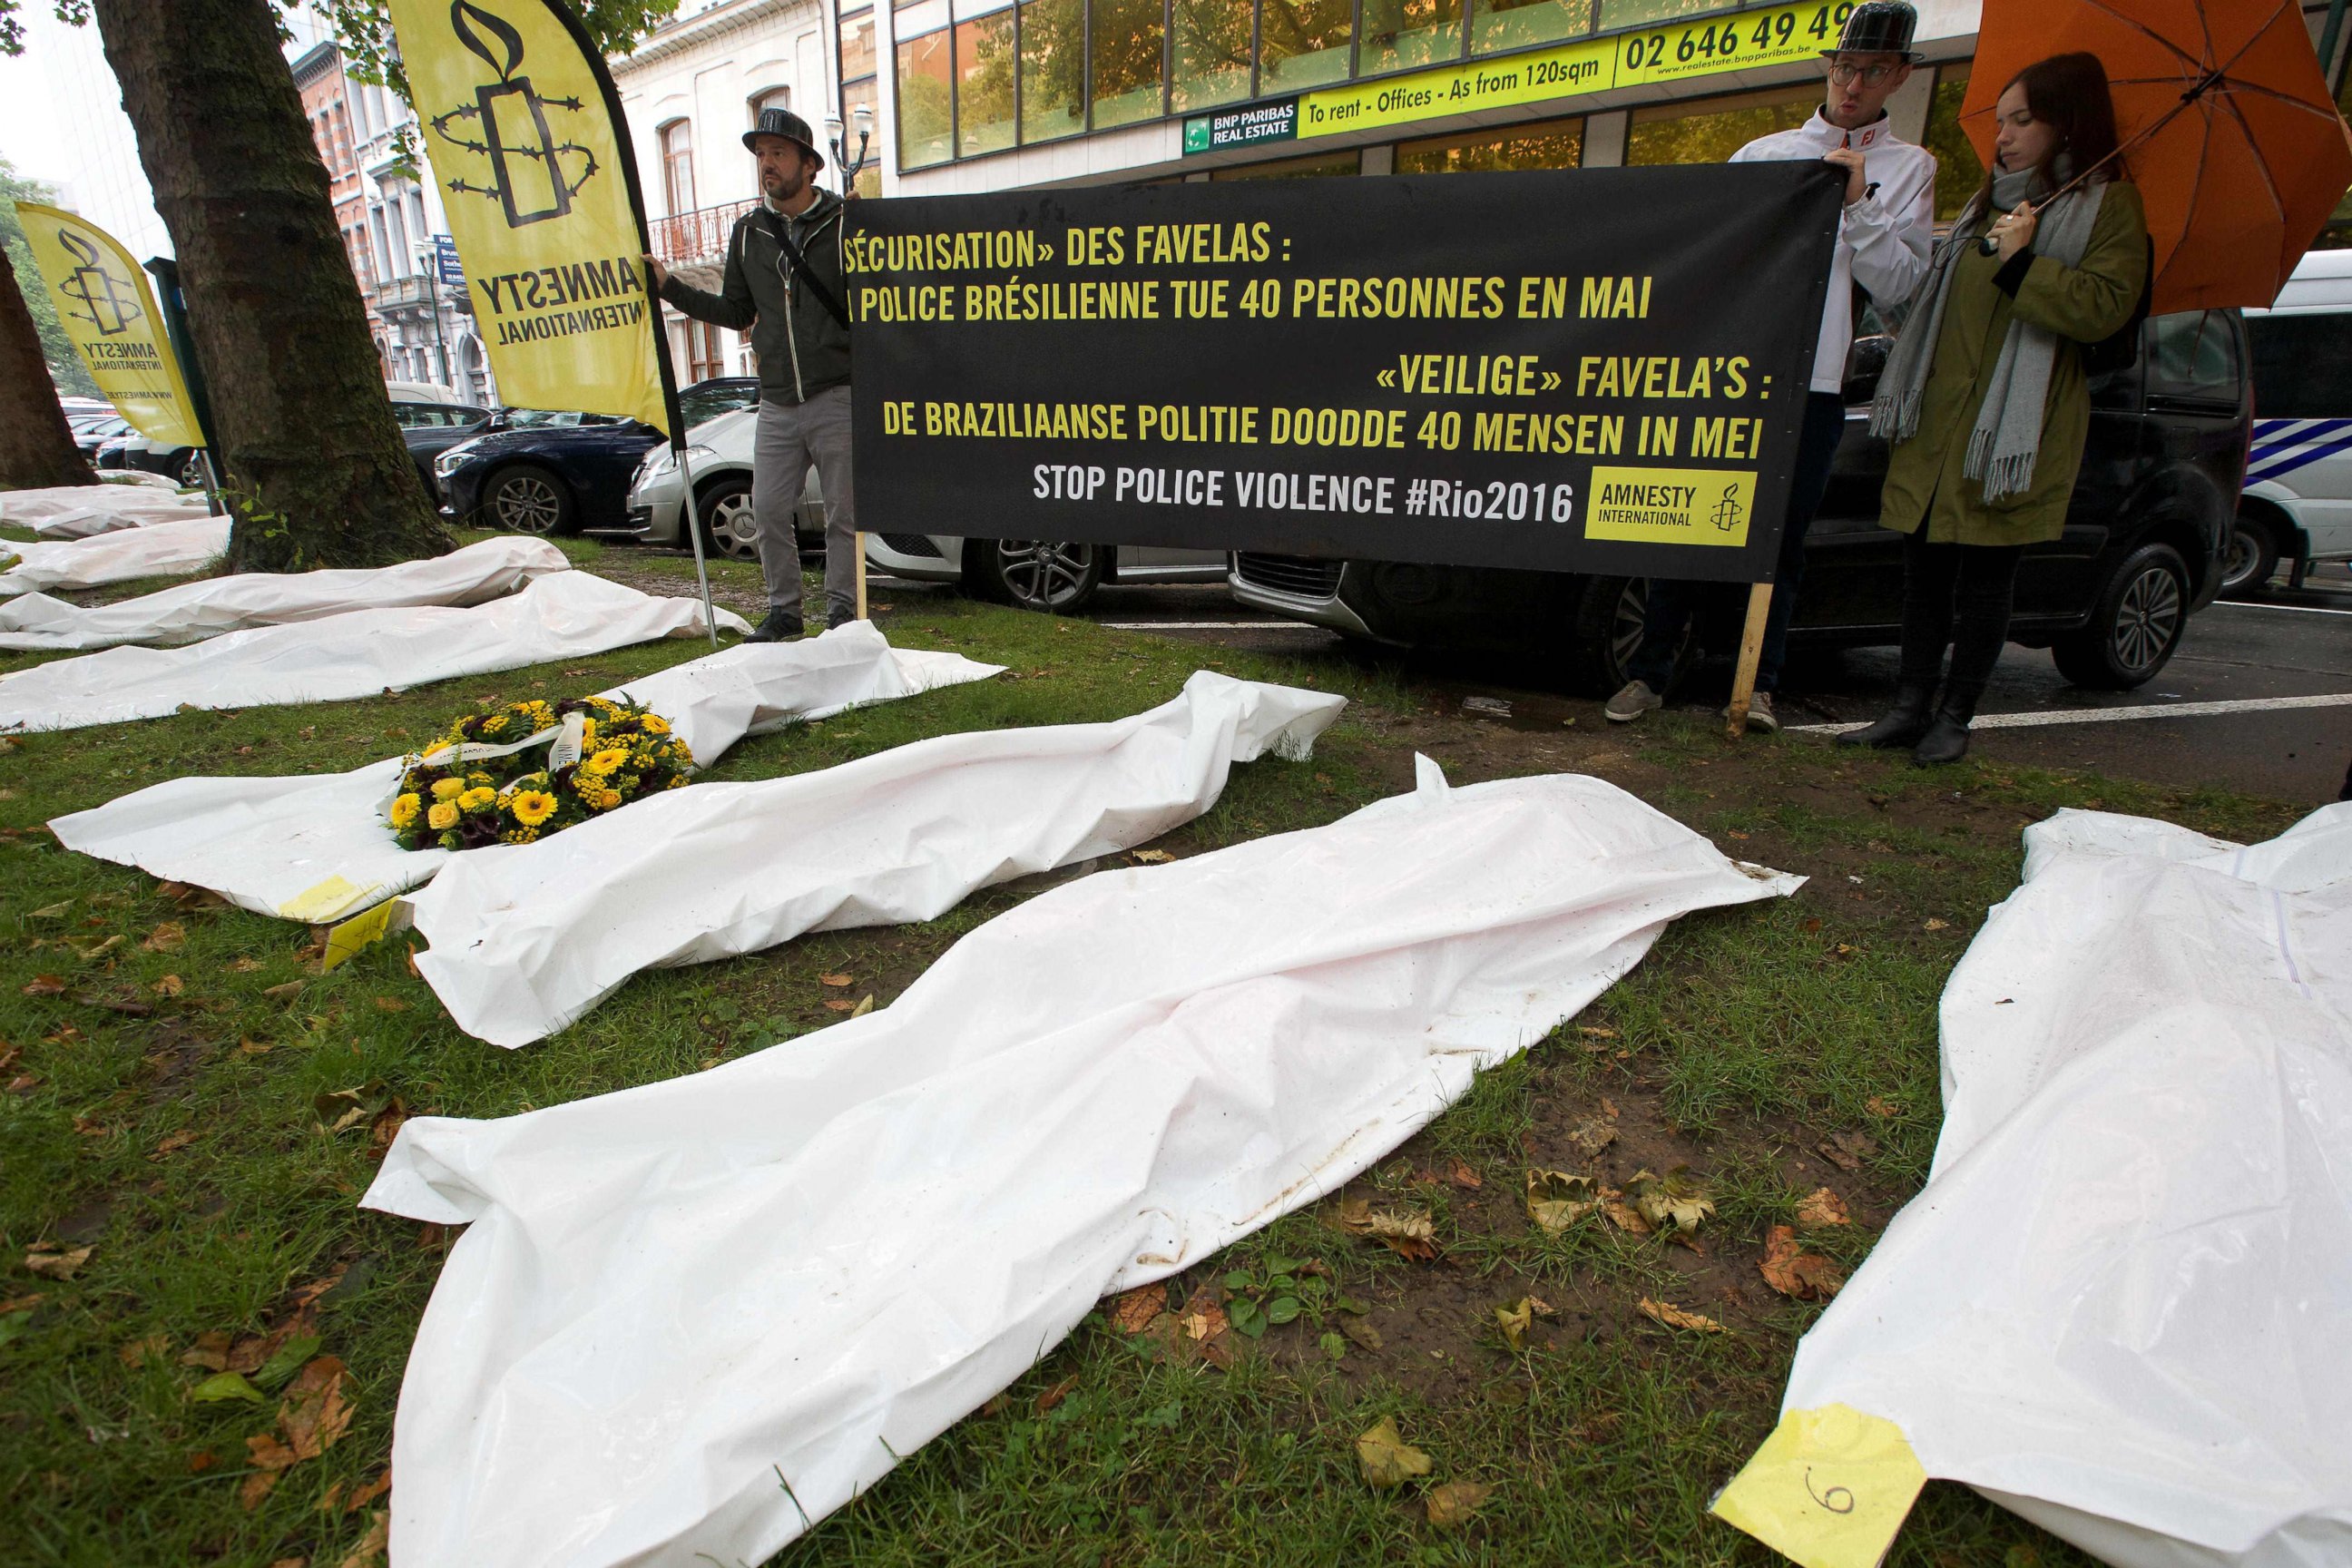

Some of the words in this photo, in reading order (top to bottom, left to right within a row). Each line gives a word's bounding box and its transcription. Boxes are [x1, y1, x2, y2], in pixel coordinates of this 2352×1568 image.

[1626, 35, 1666, 70] 02
[1676, 22, 1738, 63] 646
[1750, 13, 1796, 49] 49
[1657, 46, 1811, 75] www.realestate.bnpparibas.be
[1309, 104, 1324, 123] To
[1329, 99, 1361, 121] rent
[1377, 88, 1431, 113] Offices
[1449, 79, 1470, 101] As
[1475, 73, 1518, 95] from
[1525, 59, 1599, 86] 120sqm
[1213, 129, 1243, 144] REAL
[1245, 121, 1289, 139] ESTATE
[1214, 115, 1240, 131] BNP
[1240, 104, 1294, 125] PARIBAS
[1067, 226, 1124, 267] DES
[1136, 221, 1271, 265] FAVELAS
[860, 286, 956, 323] POLICE
[965, 275, 1158, 322] BRÉSILIENNE
[1171, 280, 1229, 318] TUE
[1240, 278, 1280, 318] 40
[1292, 276, 1505, 318] PERSONNES
[1517, 276, 1567, 318] EN
[1579, 275, 1652, 318] MAI
[1576, 356, 1750, 399] FAVELA'S
[884, 401, 916, 436] DE
[926, 402, 1128, 440] BRAZILIAANSE
[1138, 405, 1259, 444] POLITIE
[1270, 407, 1406, 449] DOODDE
[1416, 410, 1461, 451] 40
[1473, 412, 1624, 456] MENSEN
[1637, 416, 1680, 457] IN
[1690, 416, 1763, 459] MEI
[1033, 464, 1106, 501] STOP
[1115, 466, 1224, 507] POLICE
[1235, 471, 1396, 514] VIOLENCE
[1405, 477, 1573, 524] #Rio2016
[1600, 483, 1698, 509] AMNESTY
[1598, 508, 1692, 527] INTERNATIONAL
